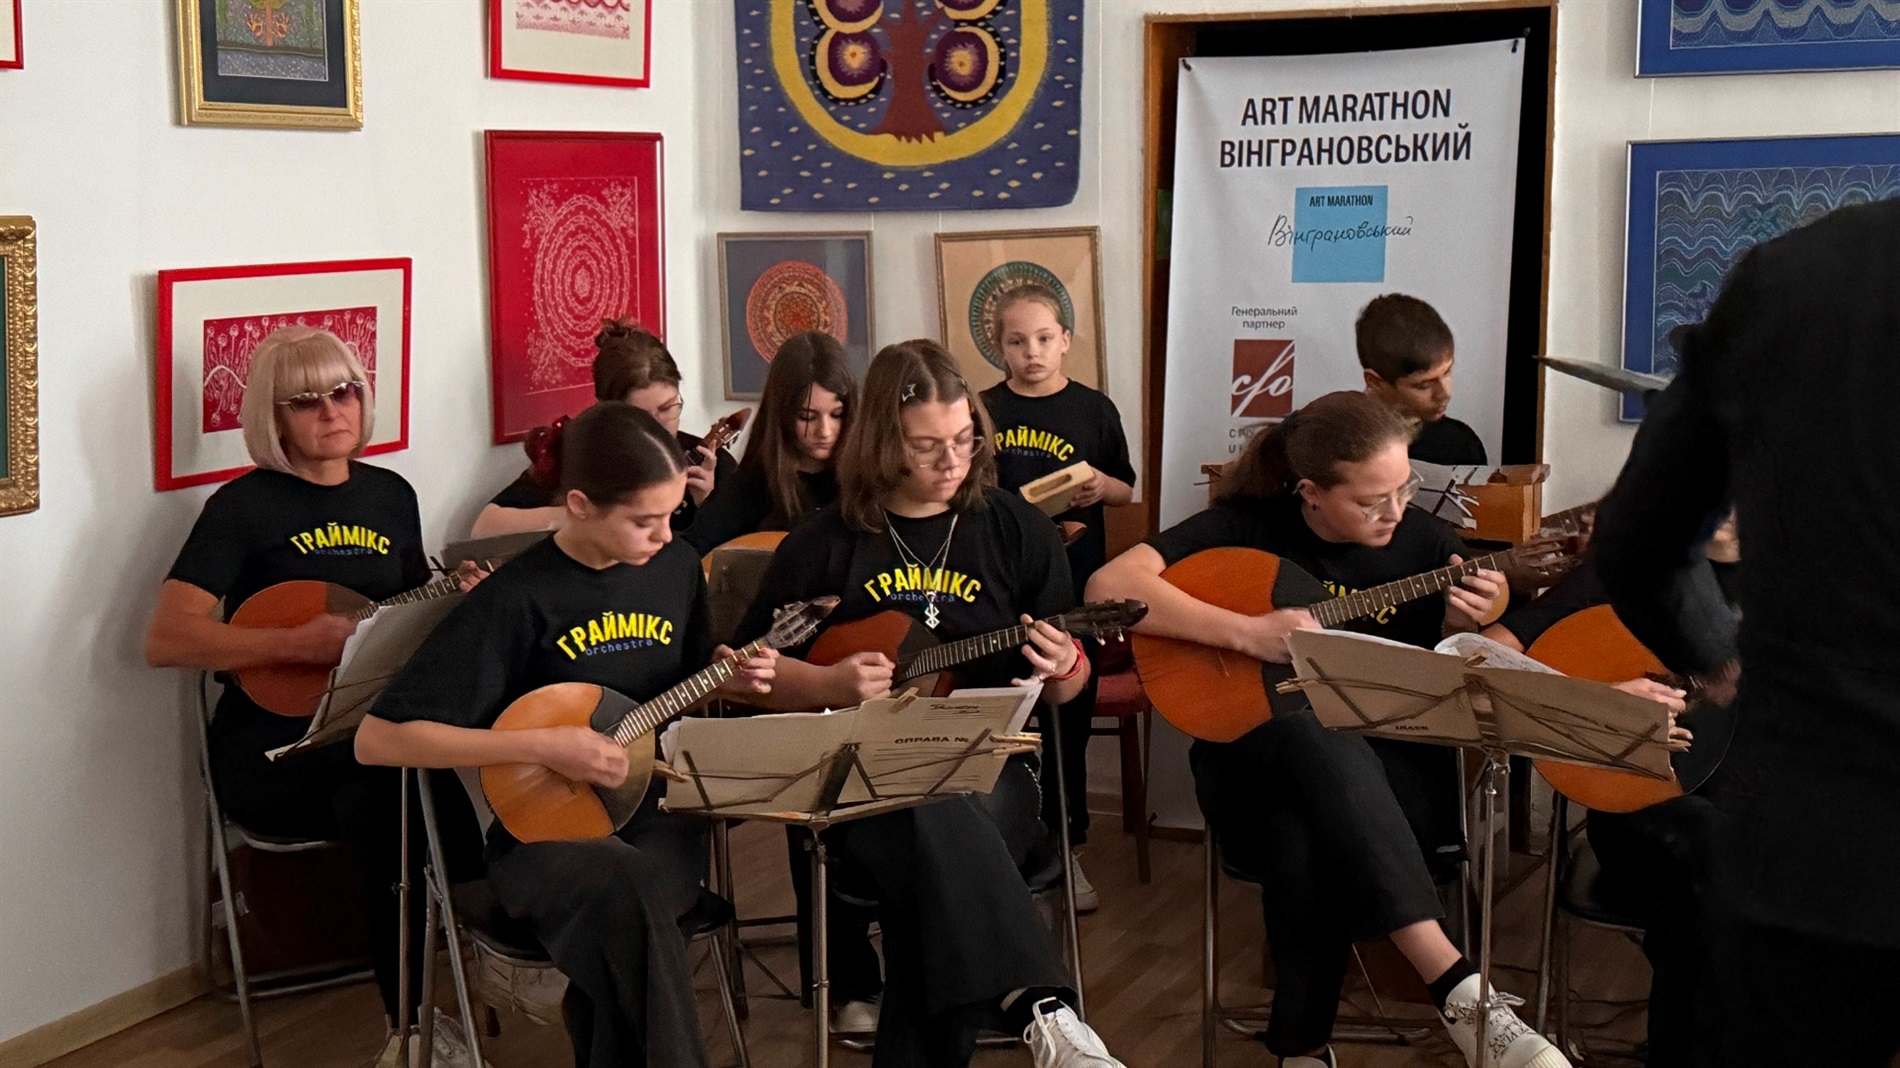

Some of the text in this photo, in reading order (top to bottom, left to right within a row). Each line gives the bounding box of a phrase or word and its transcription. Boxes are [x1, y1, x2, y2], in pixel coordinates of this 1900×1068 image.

[1241, 88, 1451, 126] ART MARATHON
[1219, 122, 1472, 168] ВІНГРАНОВСЬКИЙ
[1309, 194, 1373, 207] ART MARATHON
[1231, 306, 1298, 318] Генеральний
[1242, 320, 1286, 330] партнер
[993, 425, 1074, 462] РАЙМІКС
[585, 639, 653, 656] orchestra
